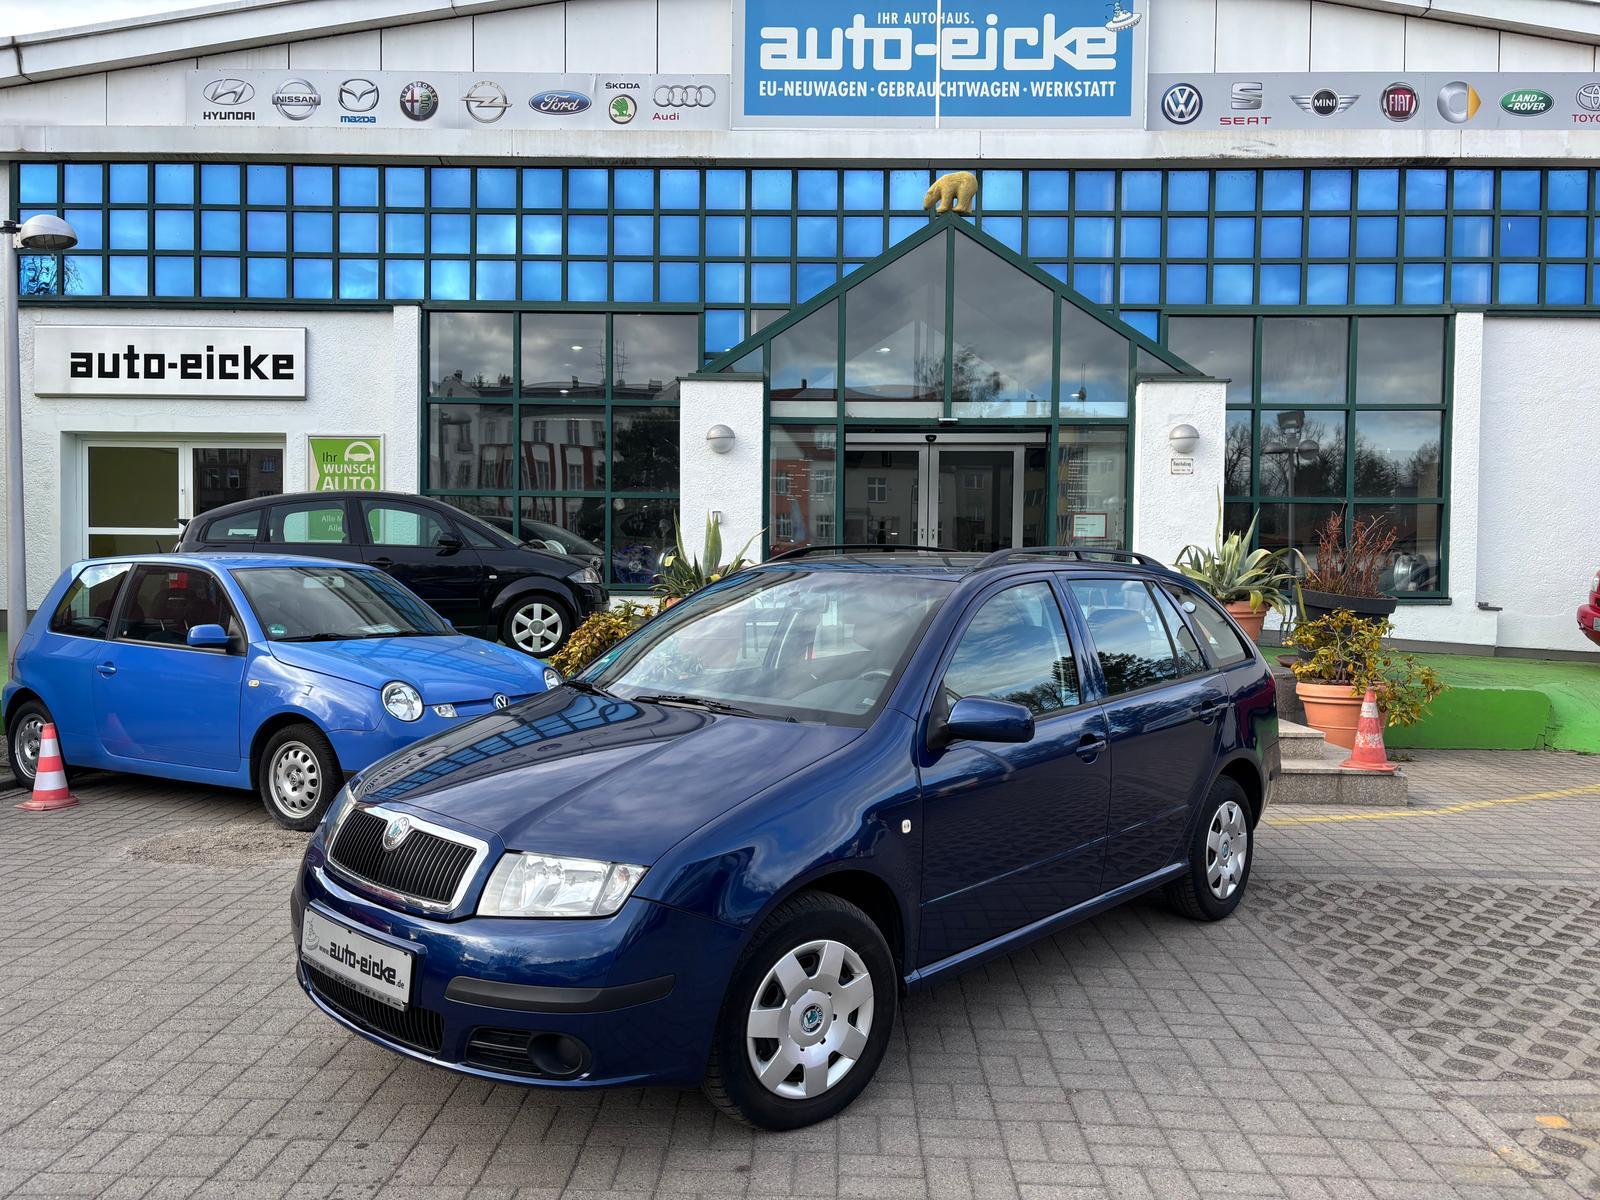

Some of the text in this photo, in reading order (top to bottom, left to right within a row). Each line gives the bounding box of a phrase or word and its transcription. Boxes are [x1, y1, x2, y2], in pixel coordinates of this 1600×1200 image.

[877, 12, 975, 24] IHR AUTOHAUS.
[760, 13, 1117, 70] auto-eicke
[759, 81, 1117, 97] EU-NEUWAGEN GEBRAUCHTWAGEN WERKSTATT
[276, 95, 317, 103] NISSAN
[540, 93, 580, 111] Ford
[1314, 98, 1336, 107] MINI
[1389, 94, 1411, 112] FIAT
[1513, 102, 1546, 111] ROVER
[203, 111, 255, 121] HYUNDAI
[340, 115, 377, 124] mazda
[652, 112, 680, 121] Audi
[1219, 117, 1272, 125] SEAT
[70, 344, 294, 380] auto-eicke
[322, 451, 338, 462] Ihr
[323, 463, 376, 474] WUNSCH
[322, 476, 376, 490] AUTO
